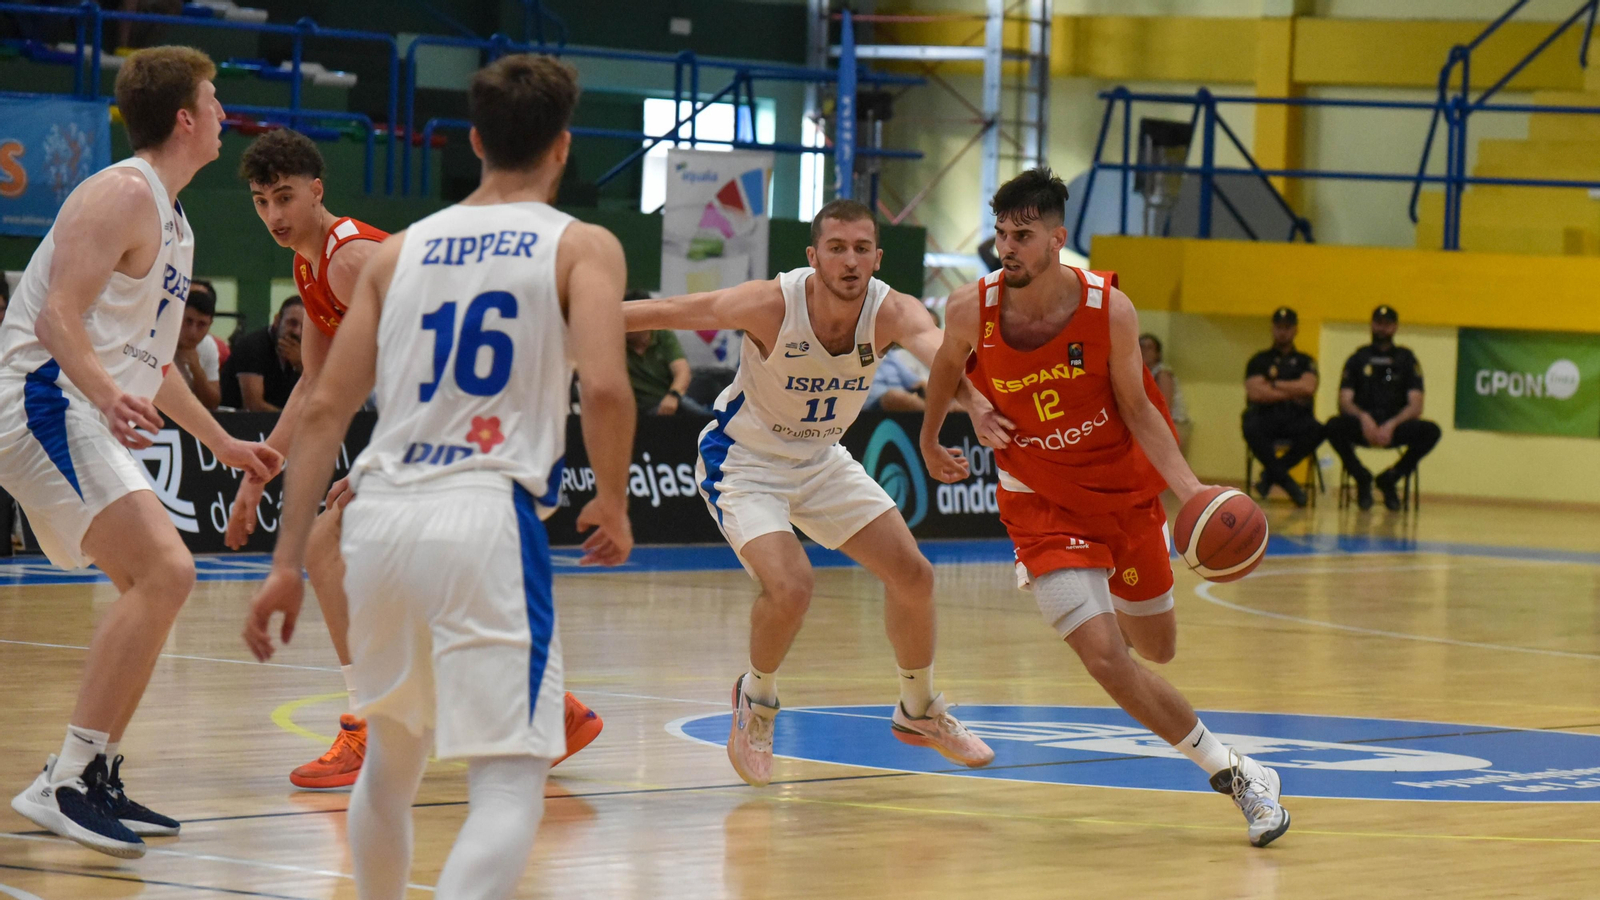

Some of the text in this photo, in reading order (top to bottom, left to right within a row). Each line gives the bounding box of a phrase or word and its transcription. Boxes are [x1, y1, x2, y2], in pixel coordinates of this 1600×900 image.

[422, 231, 538, 265] ZIPPER
[162, 262, 191, 302] RAE
[419, 290, 518, 402] 16
[785, 376, 870, 393] ISRAEL
[991, 363, 1086, 394] ESPAÑA
[1475, 369, 1544, 398] GPON
[800, 396, 838, 422] 11
[1032, 389, 1065, 422] 12
[1014, 407, 1109, 450] endesa
[561, 466, 596, 491] RUP
[629, 451, 698, 508] ajas
[937, 479, 999, 515] anda
